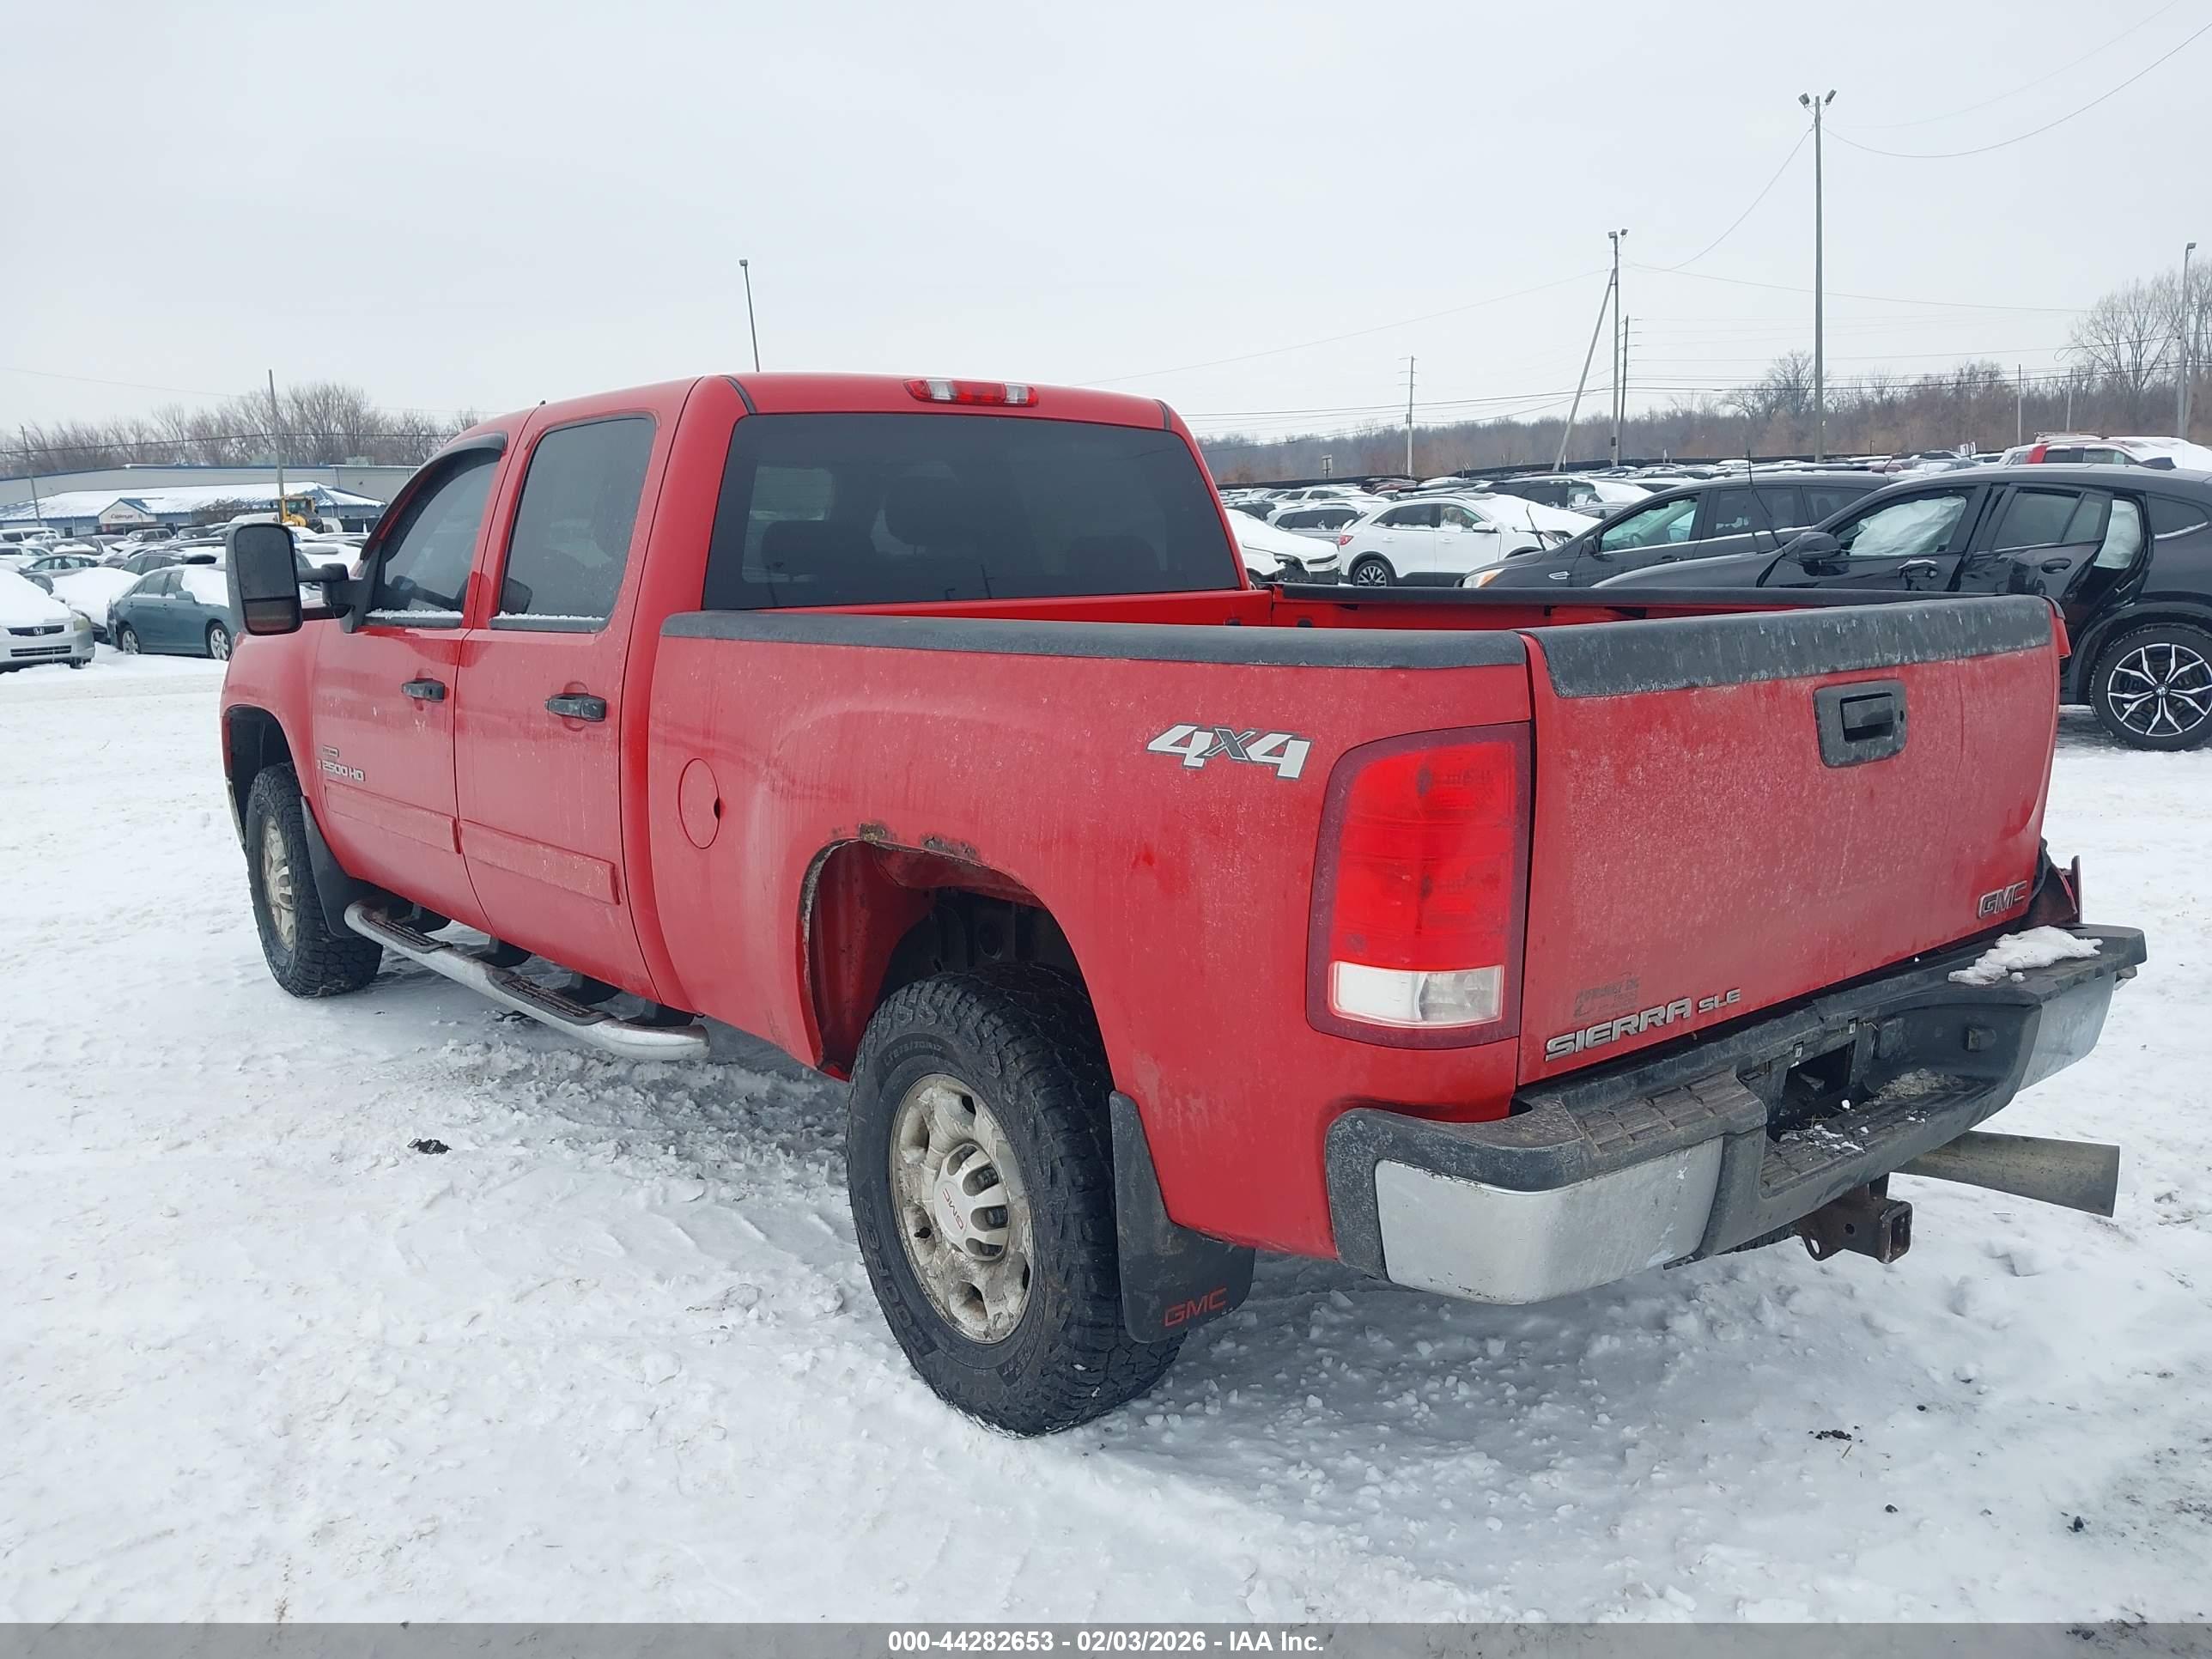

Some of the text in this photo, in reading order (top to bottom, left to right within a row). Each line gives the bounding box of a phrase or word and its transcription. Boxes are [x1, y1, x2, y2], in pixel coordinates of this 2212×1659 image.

[1978, 880, 2027, 919] GMC
[1545, 988, 1741, 1062] SIERRA SLE
[942, 1188, 964, 1231] GMC
[1164, 1286, 1228, 1328] GMC
